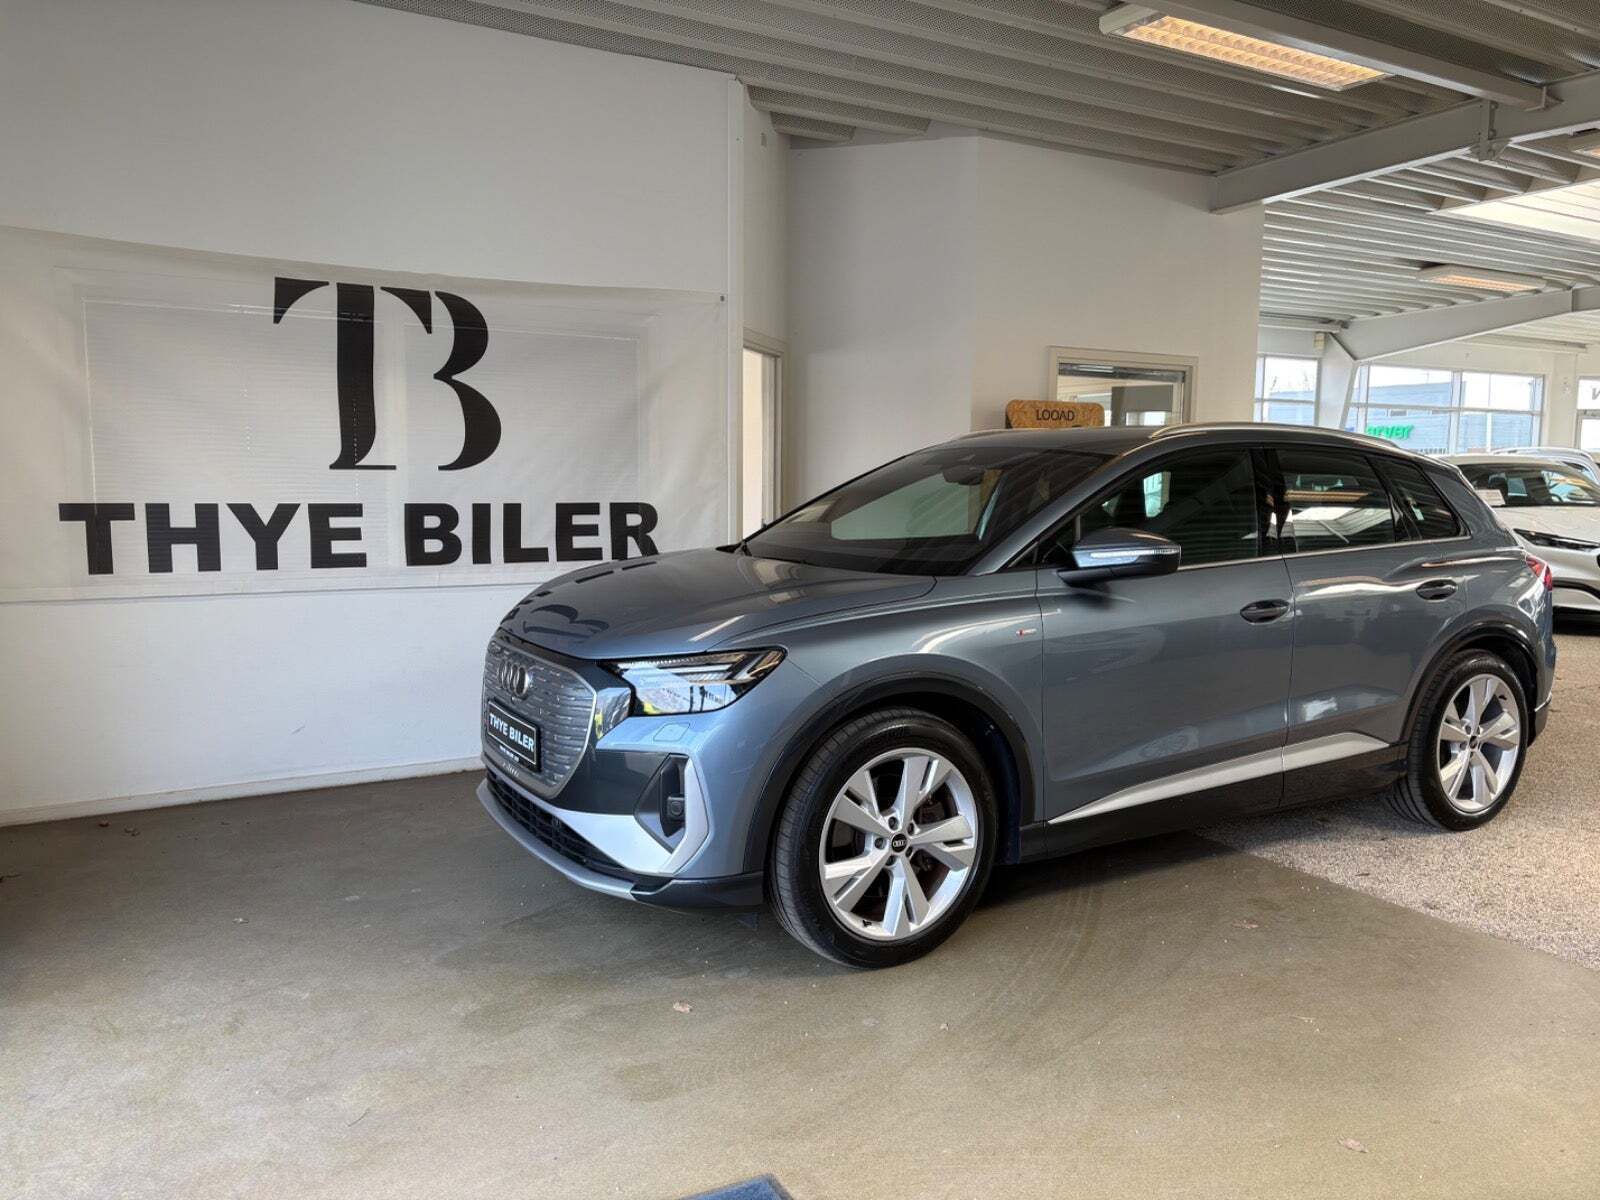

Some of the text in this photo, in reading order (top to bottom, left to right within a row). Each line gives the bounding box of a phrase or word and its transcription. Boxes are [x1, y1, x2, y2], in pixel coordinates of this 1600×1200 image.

[59, 502, 659, 575] THYE BILER
[490, 713, 534, 752] THYE BILER
